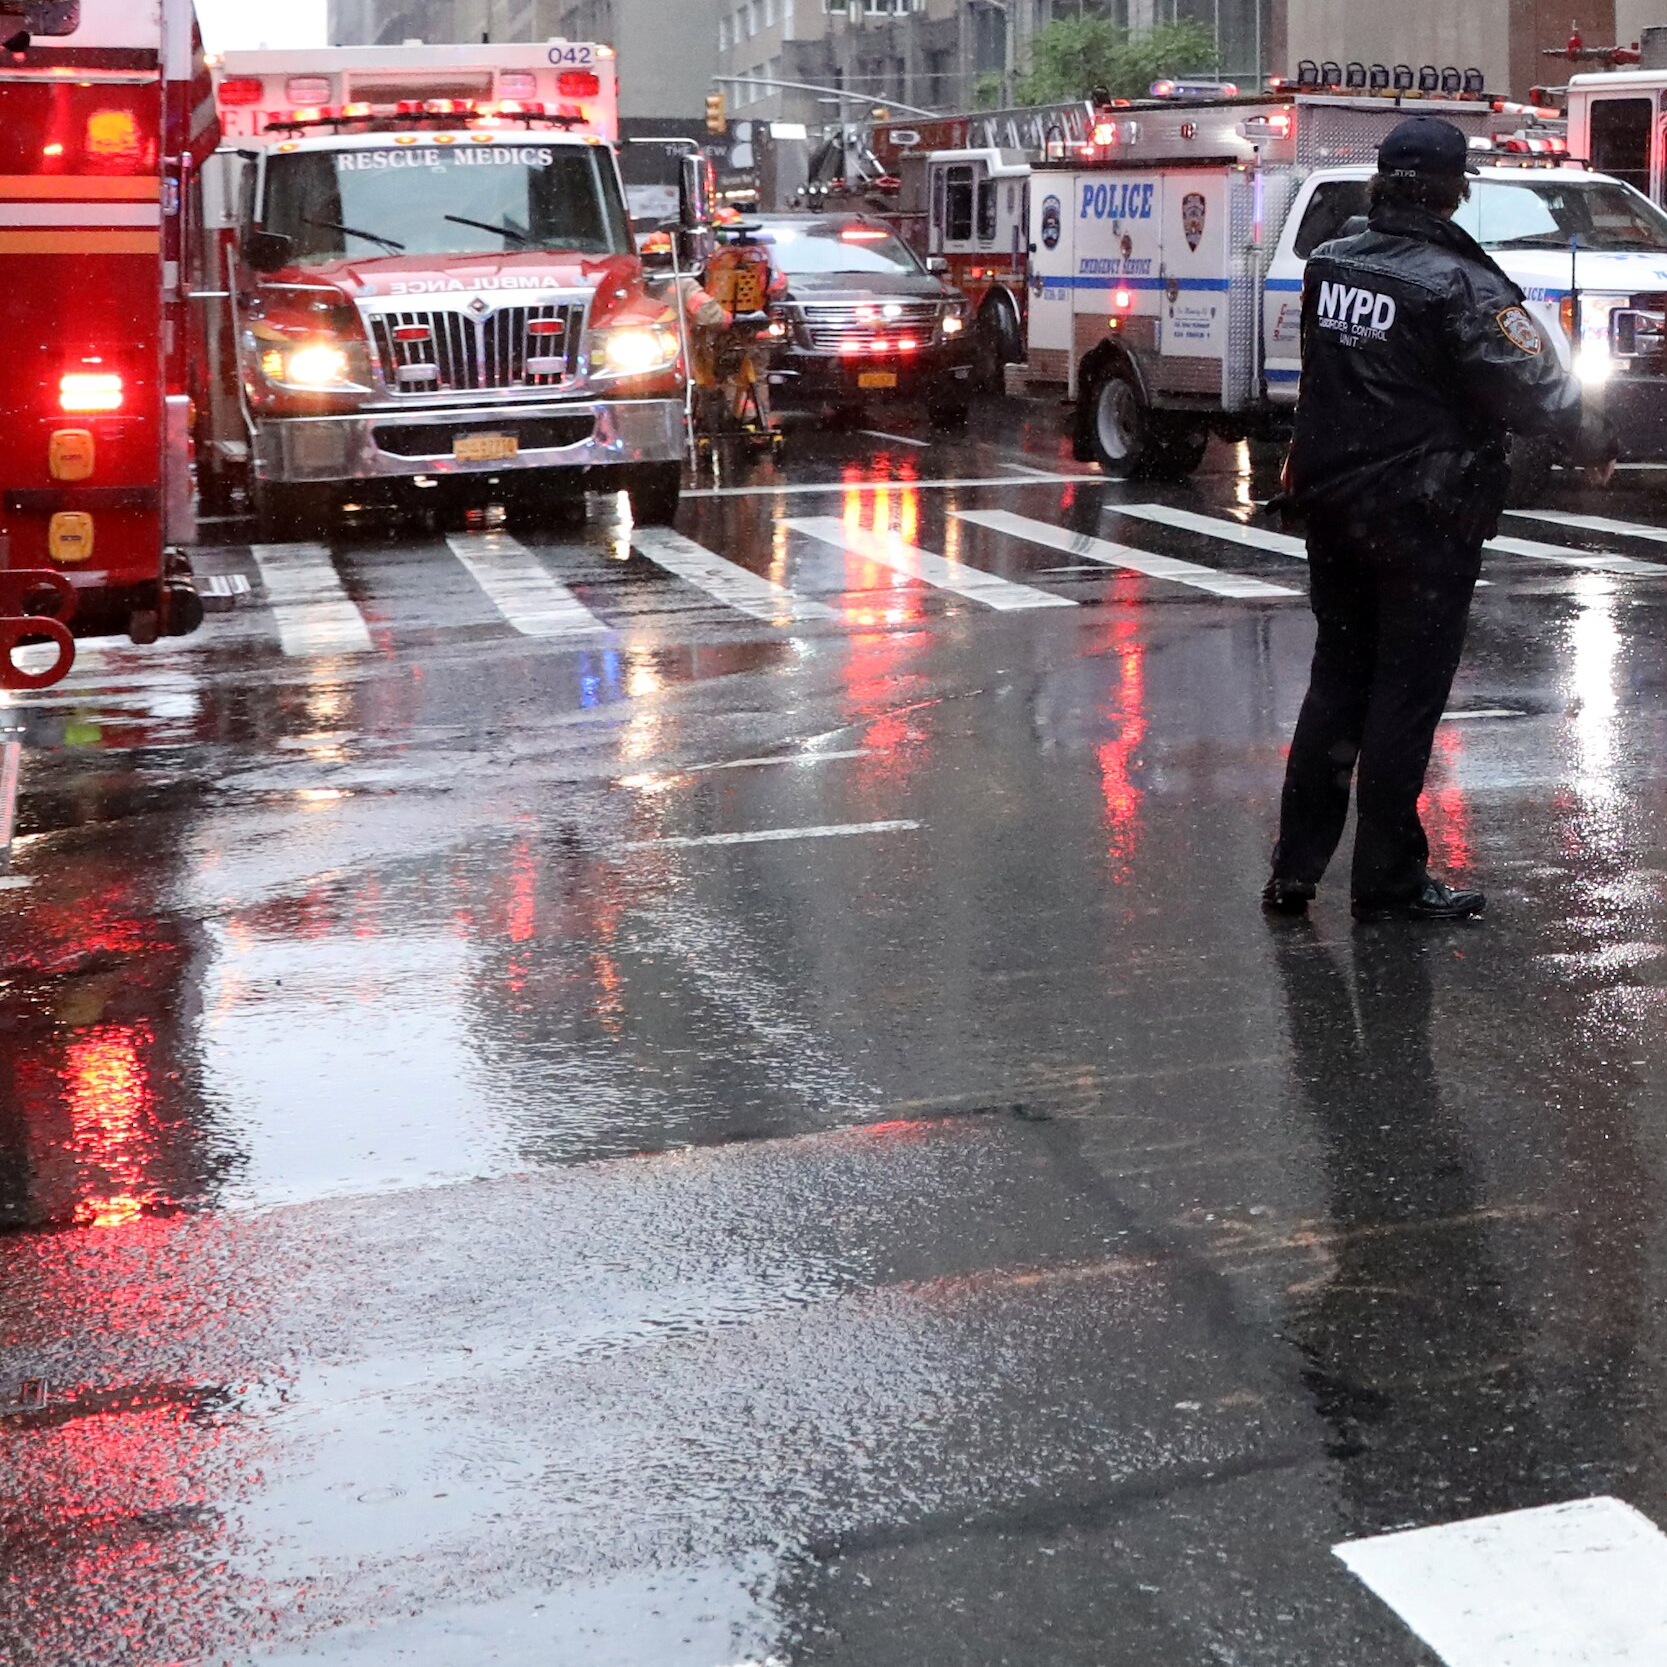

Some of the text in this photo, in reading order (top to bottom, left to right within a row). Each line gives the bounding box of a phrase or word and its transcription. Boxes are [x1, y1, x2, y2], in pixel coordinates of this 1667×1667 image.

[548, 45, 592, 65] 042
[338, 147, 554, 171] RESCUE MEDICS
[1080, 184, 1153, 219] POLICE
[1079, 258, 1152, 275] EMERGENCY SERVICE
[1317, 280, 1396, 332] NYPD
[1339, 335, 1359, 348] UNIT
[1351, 322, 1388, 342] CONTROL
